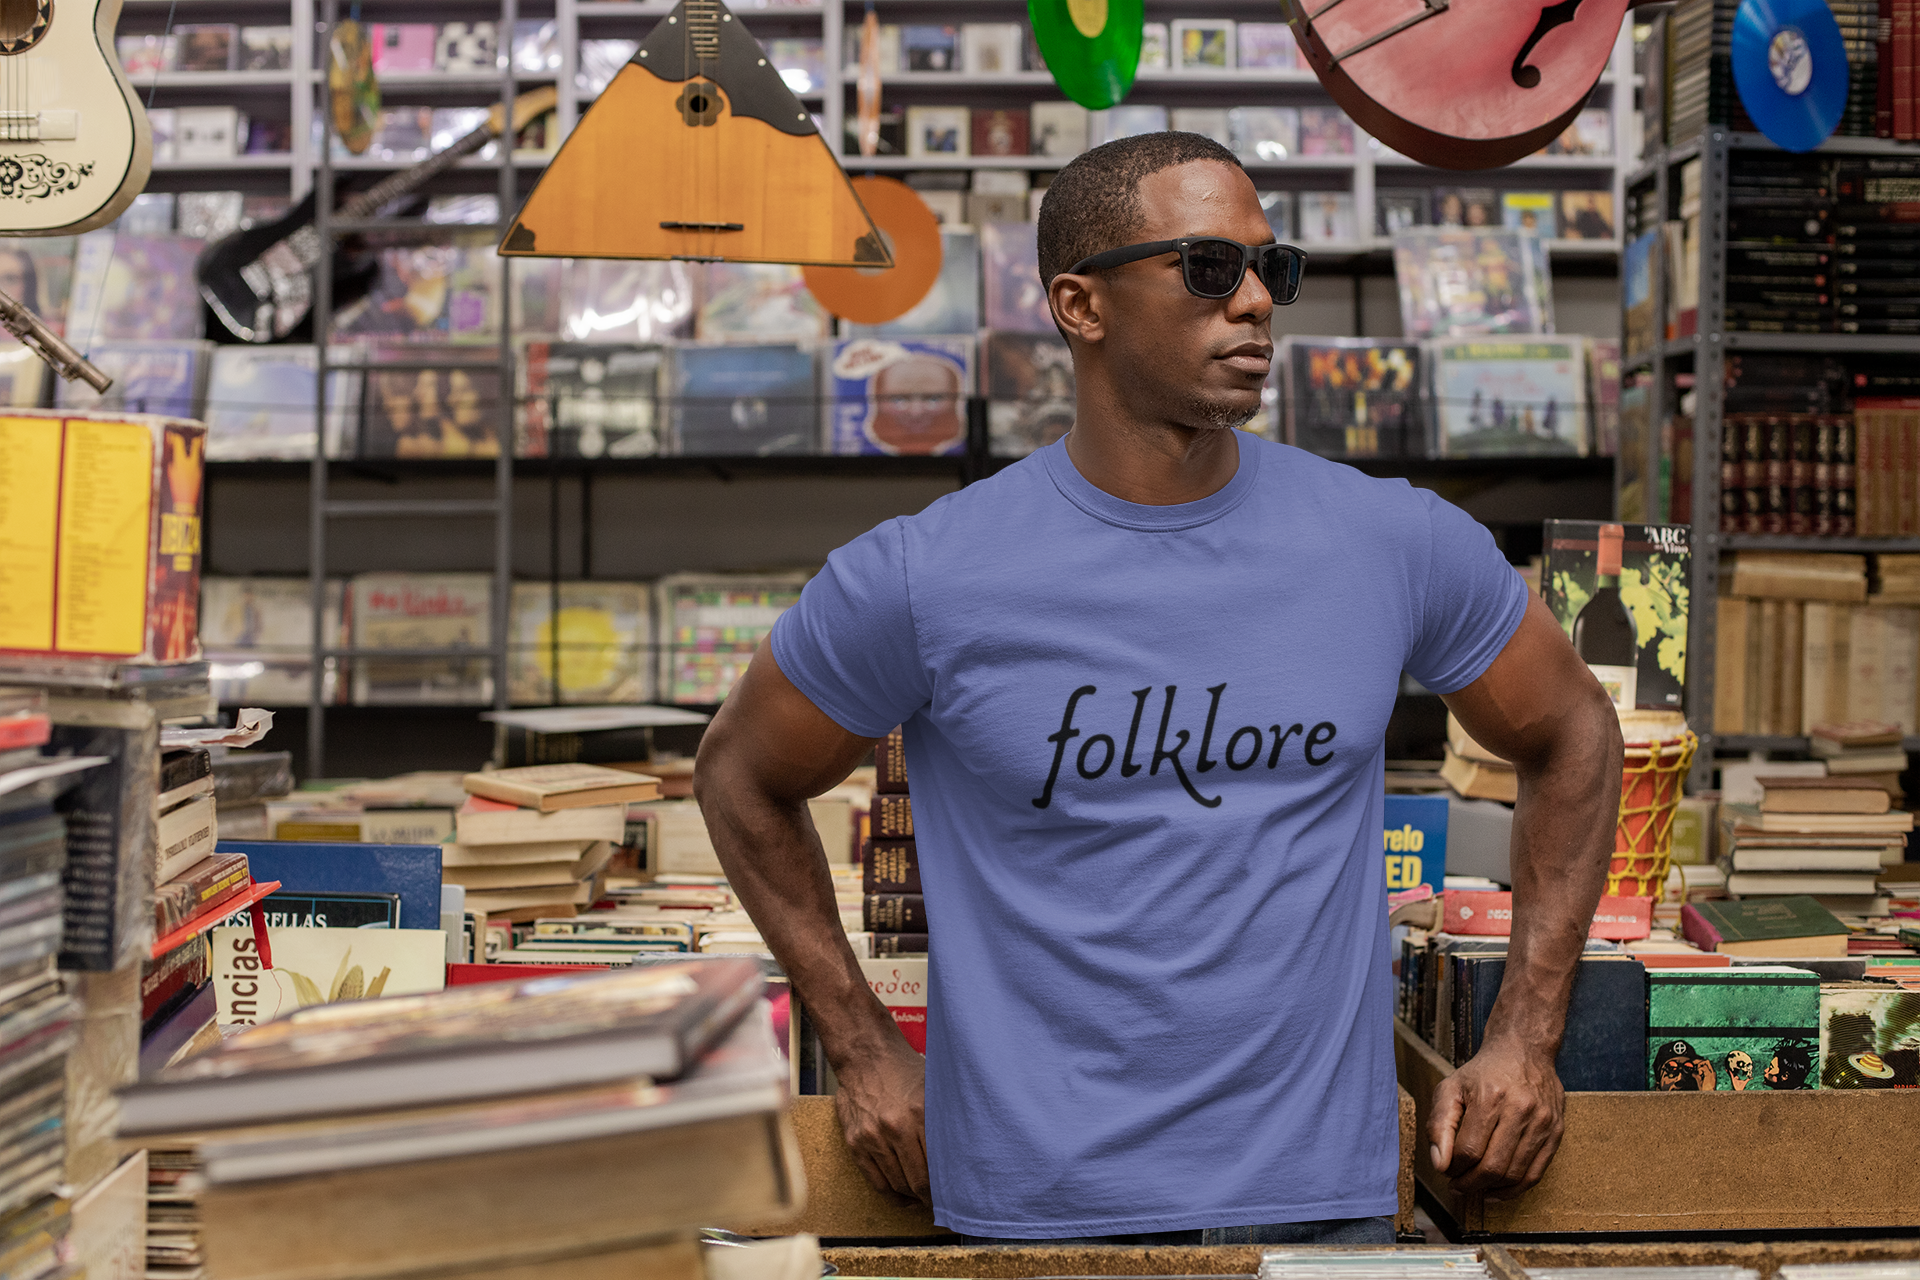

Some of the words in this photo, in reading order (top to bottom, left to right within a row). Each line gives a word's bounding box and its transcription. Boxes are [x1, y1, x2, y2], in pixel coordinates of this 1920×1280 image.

[1648, 527, 1686, 544] ABC
[1031, 682, 1337, 809] folklore
[881, 797, 889, 835] AMADO
[874, 847, 882, 884] AMADO
[1487, 909, 1512, 920] INSO
